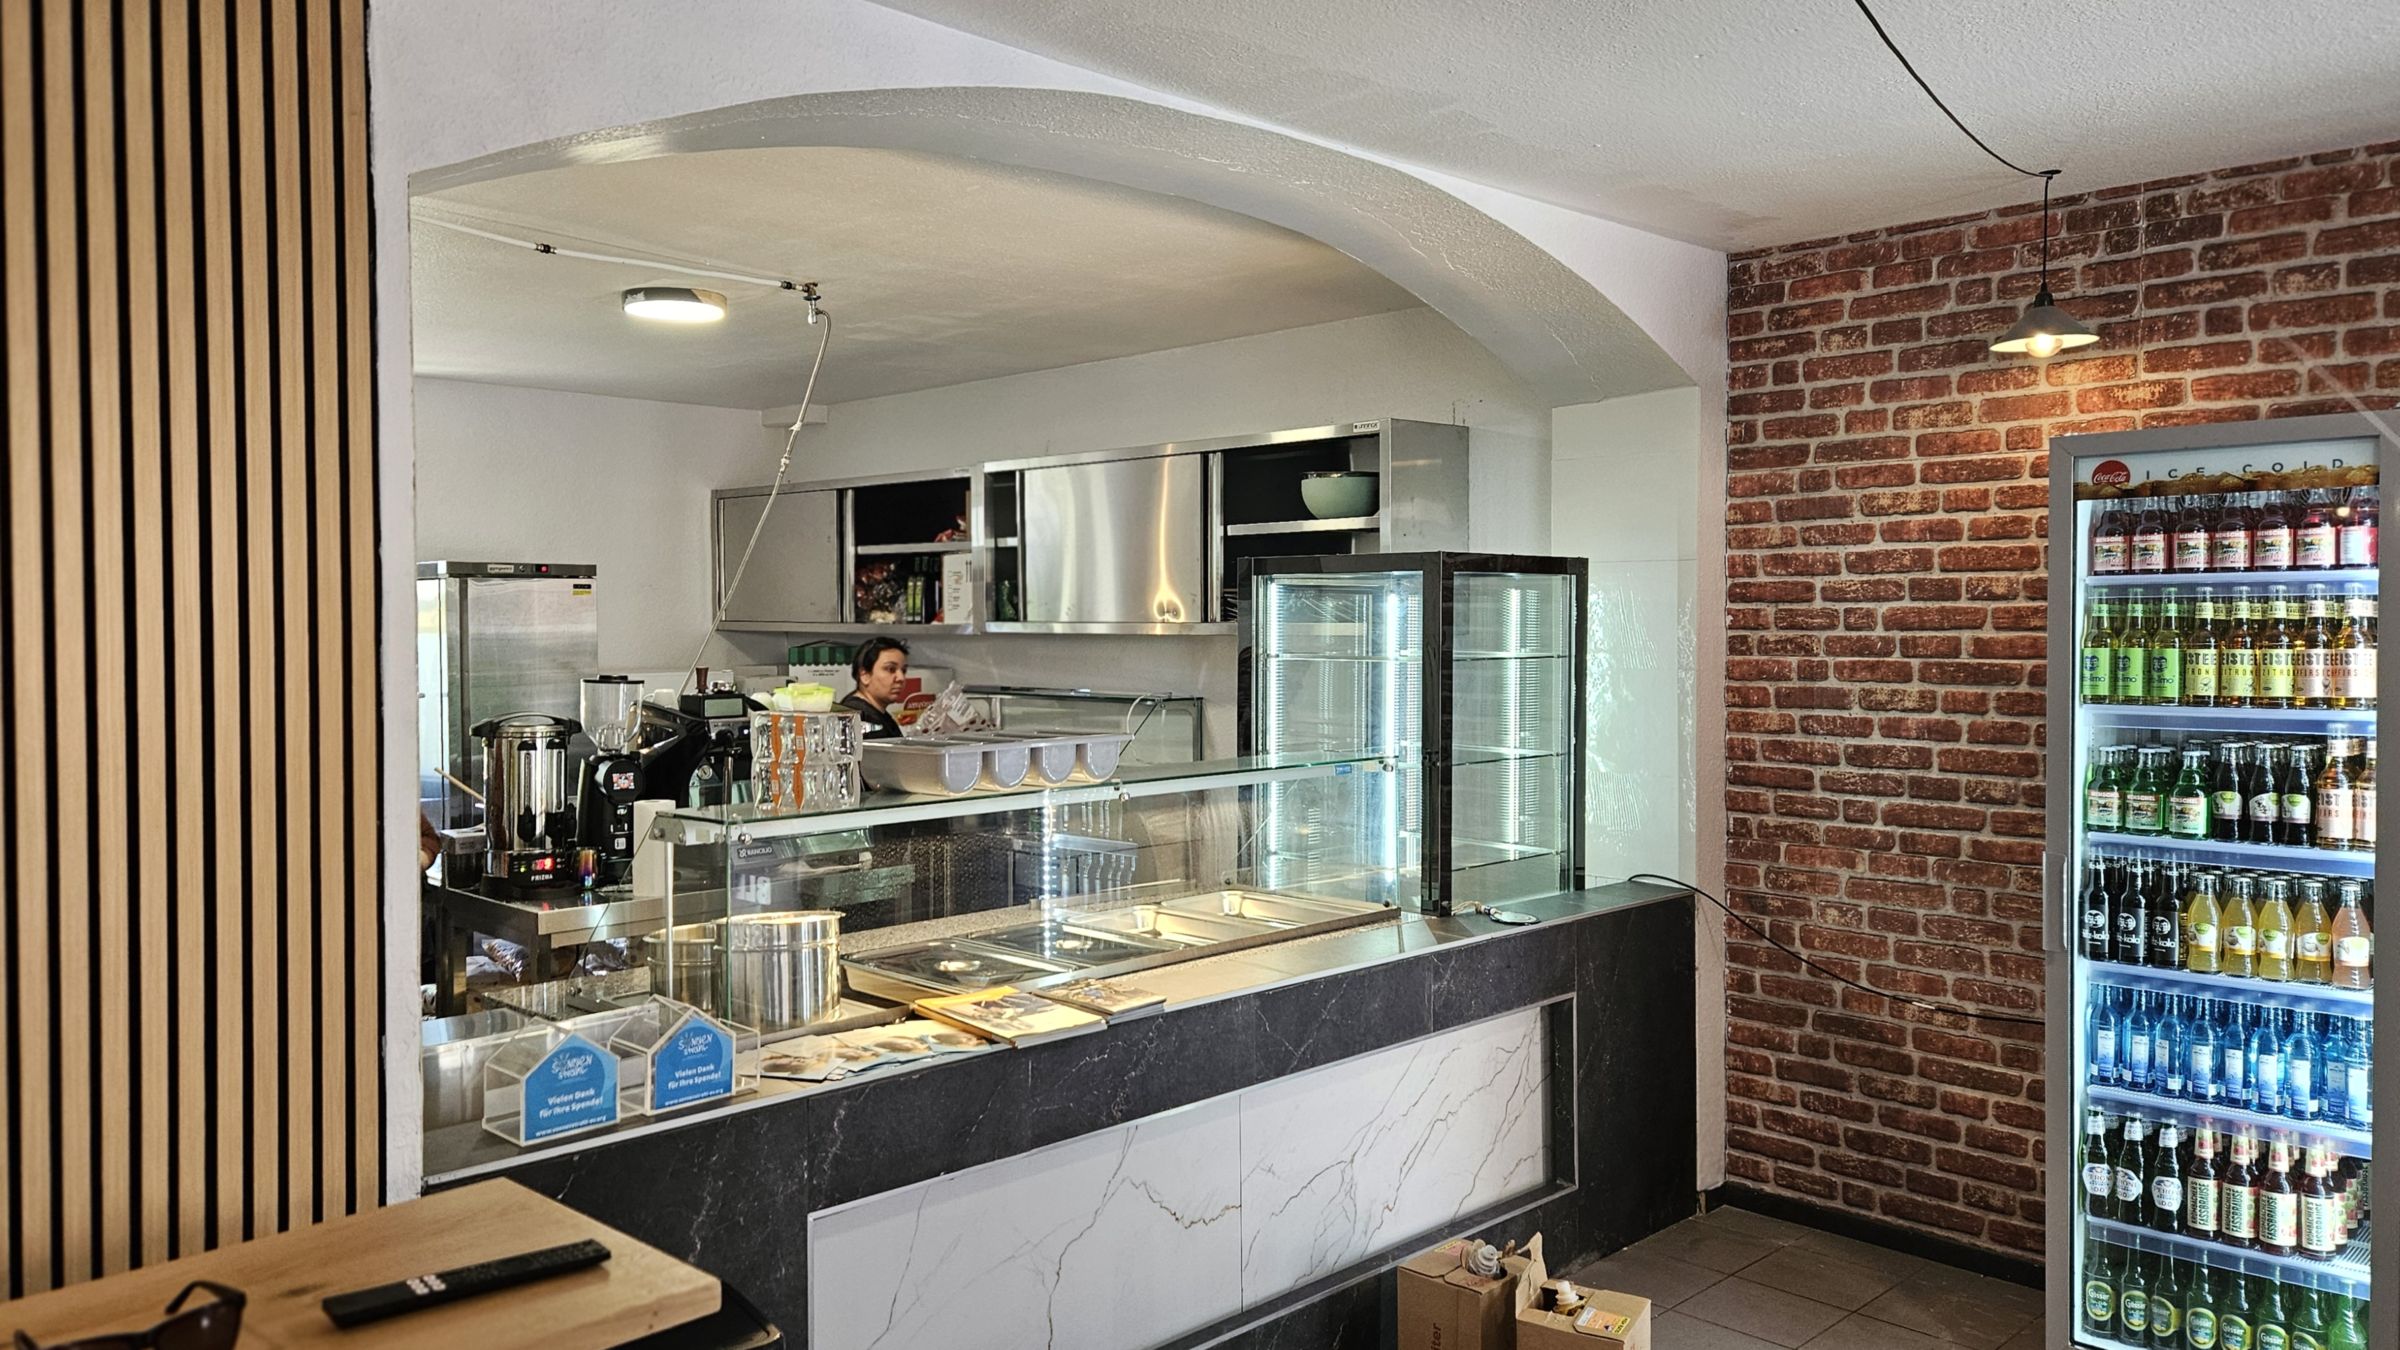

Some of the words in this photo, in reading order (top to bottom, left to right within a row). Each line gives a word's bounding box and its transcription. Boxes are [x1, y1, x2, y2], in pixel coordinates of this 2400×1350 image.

[2262, 652, 2296, 666] EISTE
[674, 1068, 697, 1079] Vielen
[697, 1063, 715, 1074] Dank
[667, 1080, 679, 1091] für
[547, 1093, 574, 1106] Vielen
[574, 1087, 596, 1099] Dank
[539, 1108, 552, 1119] für
